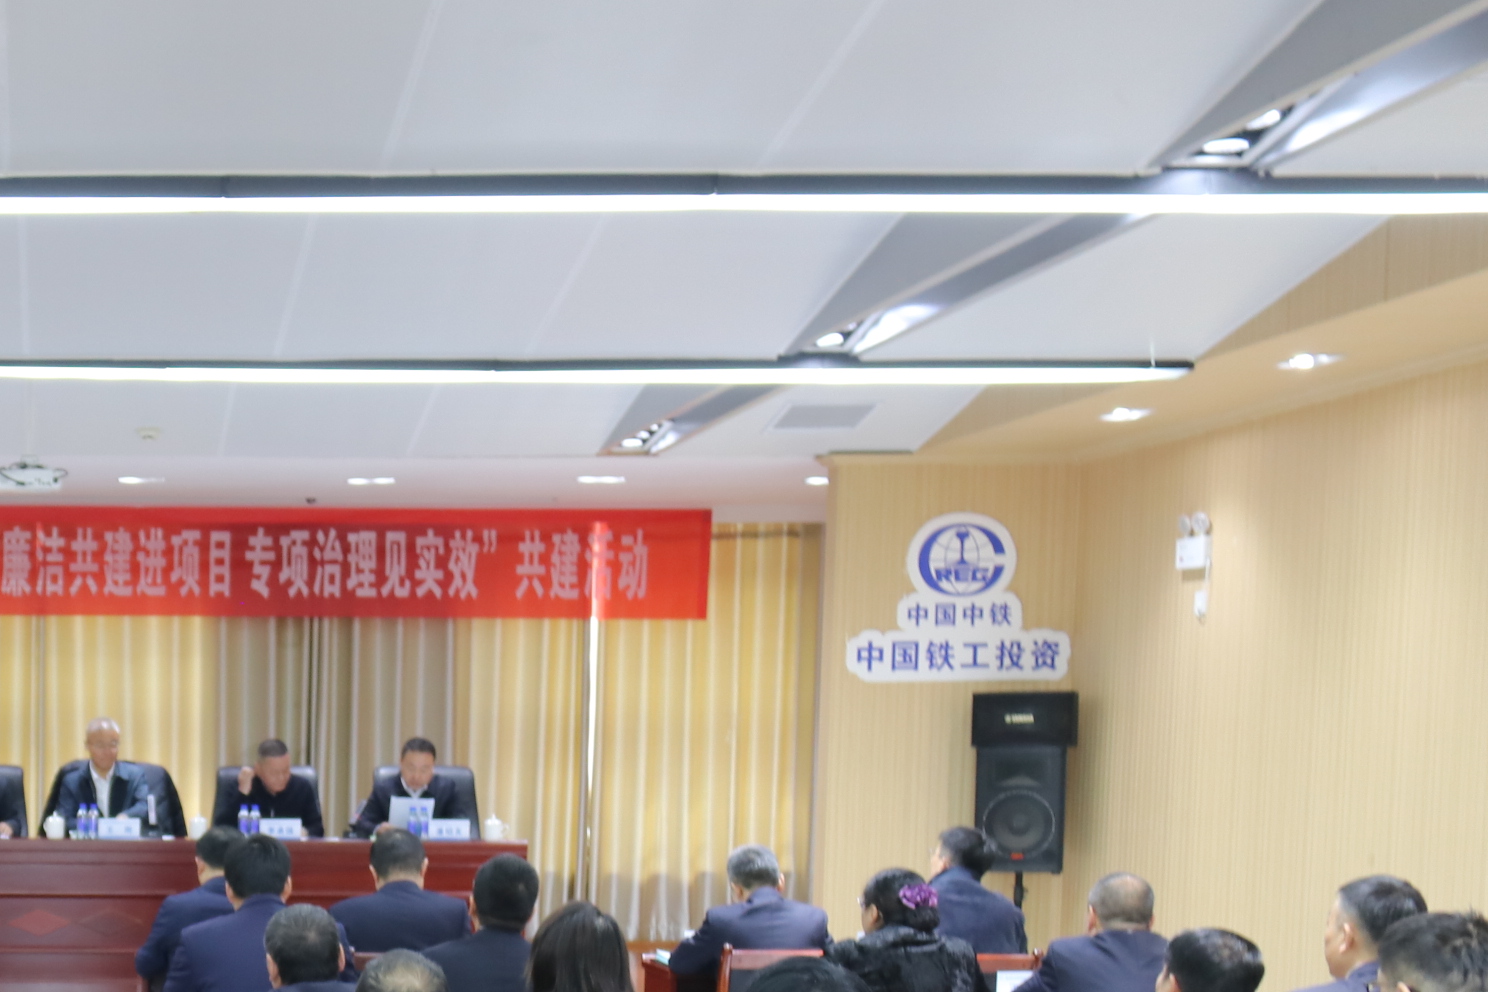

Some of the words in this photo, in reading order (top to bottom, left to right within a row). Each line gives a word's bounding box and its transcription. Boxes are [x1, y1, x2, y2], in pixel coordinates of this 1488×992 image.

[516, 528, 648, 600] 共建活动
[907, 602, 1011, 627] 中国中铁
[857, 640, 1060, 672] 中国铁工投资
